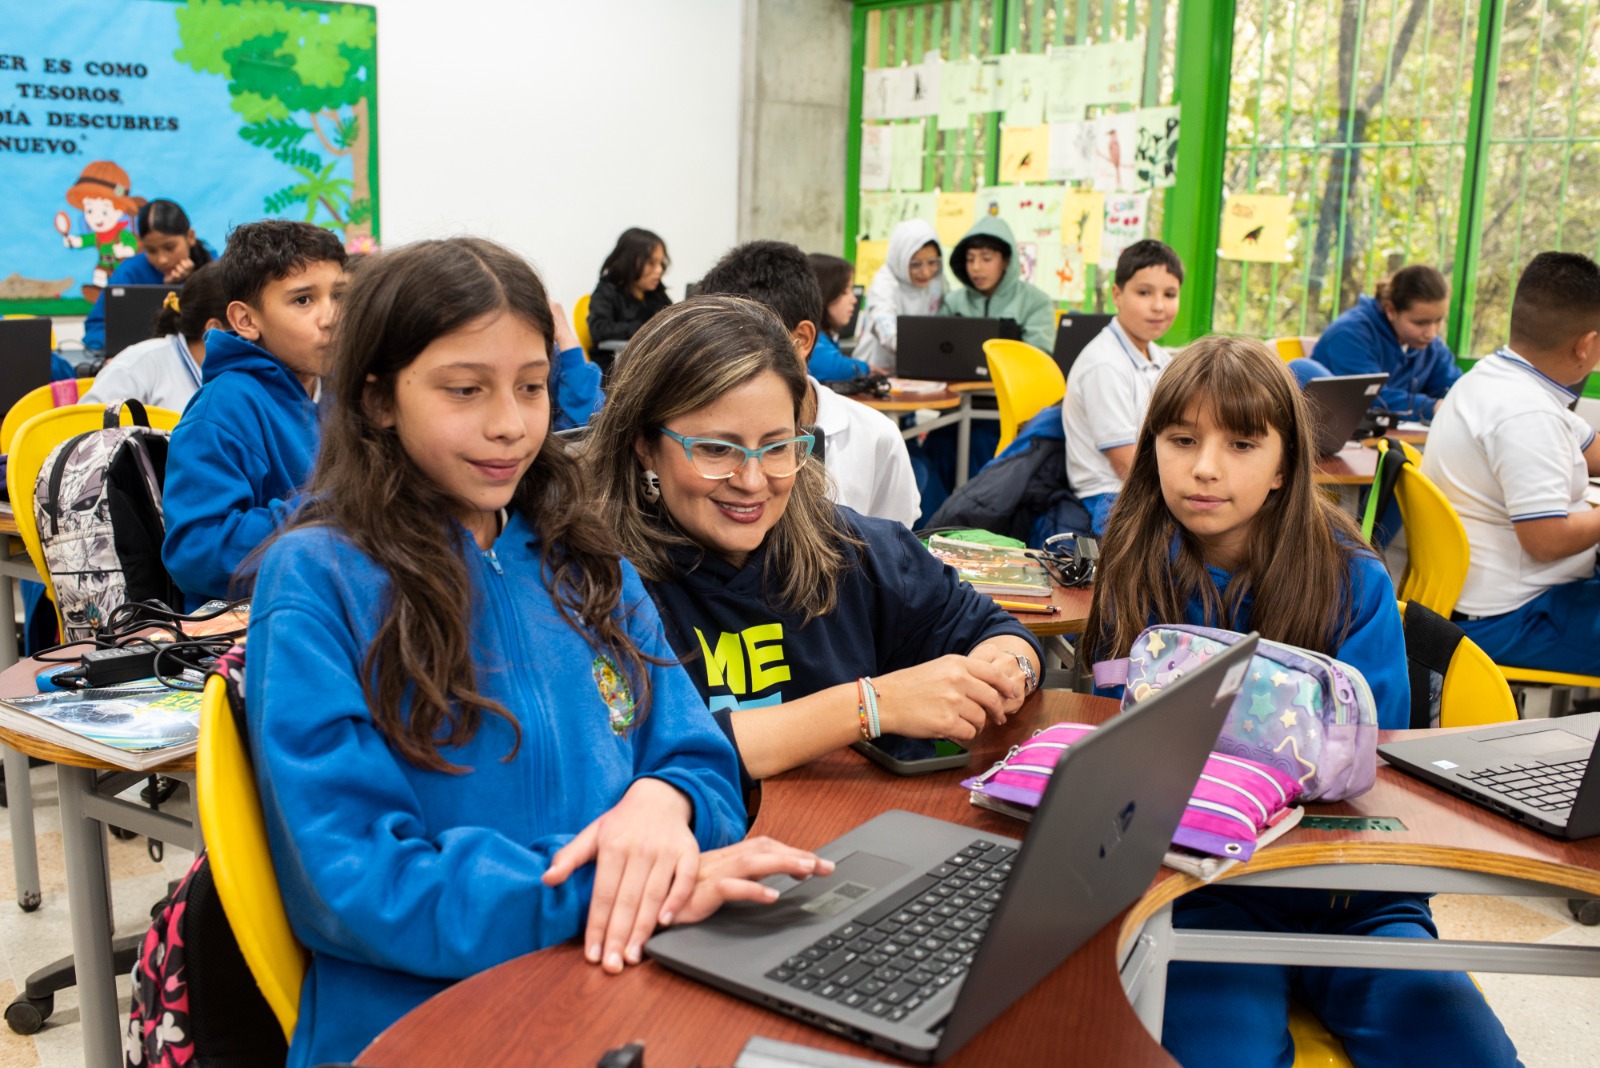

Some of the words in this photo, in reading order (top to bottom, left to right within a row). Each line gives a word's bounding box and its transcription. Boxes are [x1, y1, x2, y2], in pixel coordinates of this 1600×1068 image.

[43, 58, 72, 74] ES
[84, 61, 149, 78] COMO
[47, 111, 180, 132] DESCUBRES
[693, 622, 791, 694] ME
